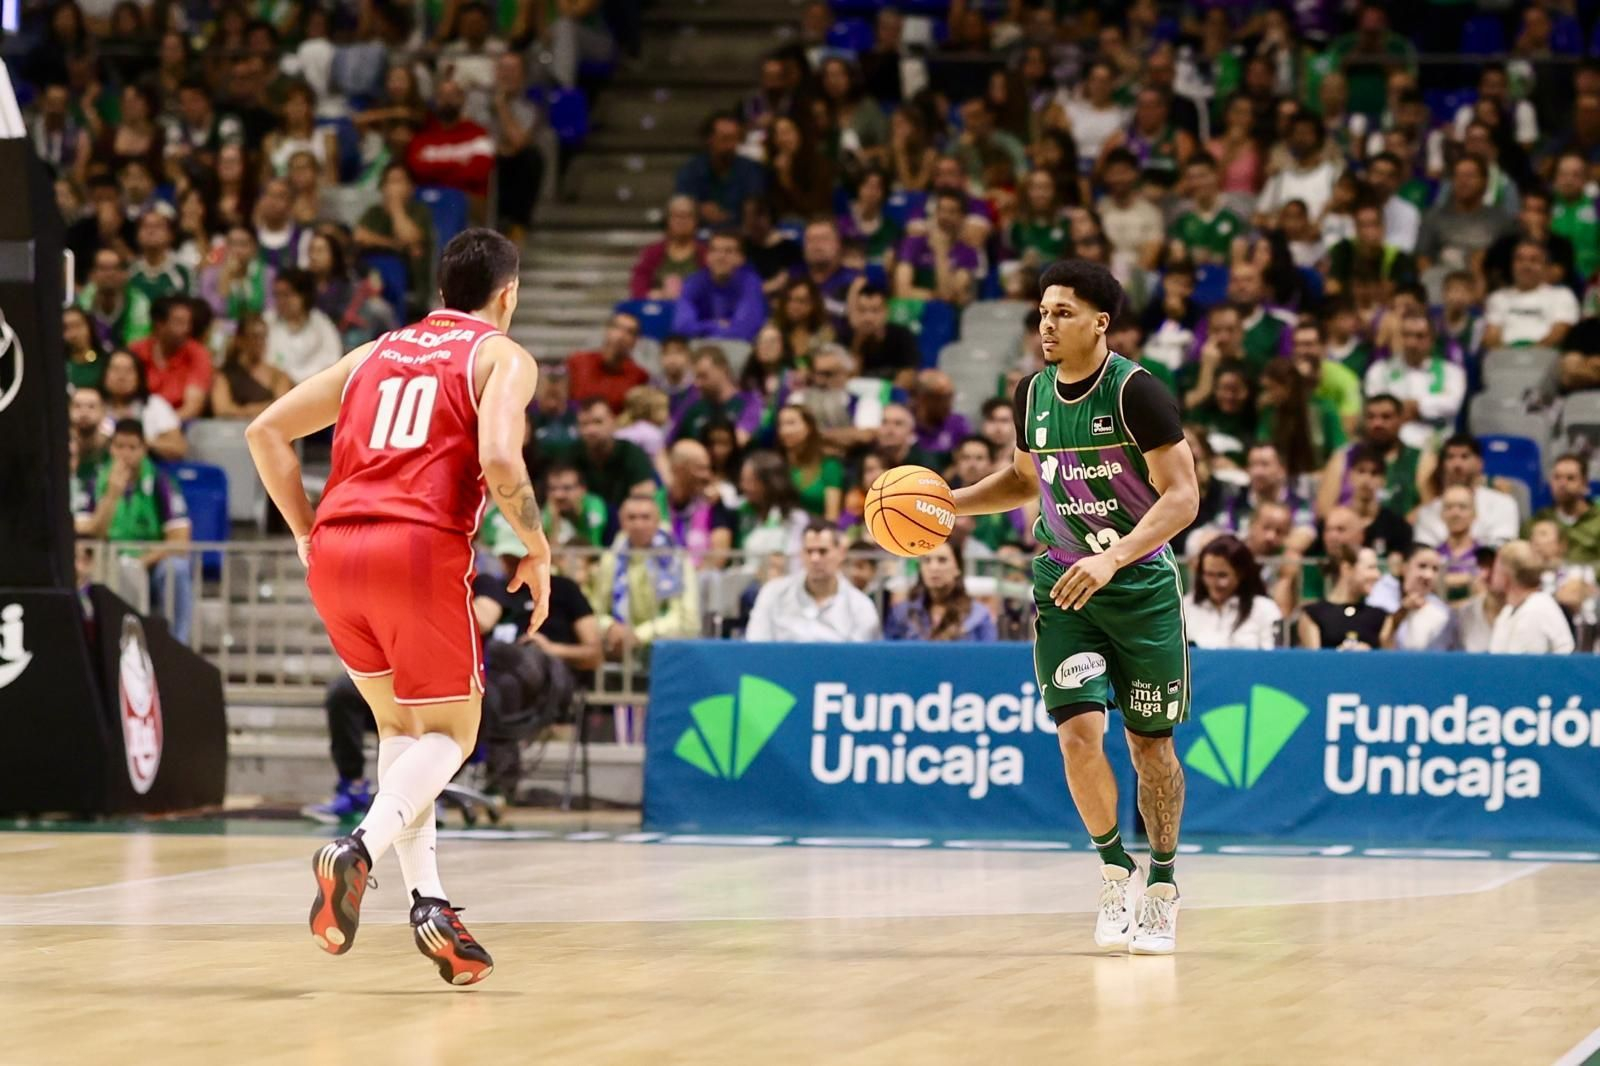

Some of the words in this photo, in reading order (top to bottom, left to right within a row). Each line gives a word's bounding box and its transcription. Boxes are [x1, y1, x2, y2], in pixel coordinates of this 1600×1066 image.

[368, 375, 438, 450] 10
[1061, 460, 1123, 481] Unicaja
[915, 499, 956, 530] Wilson
[812, 682, 1058, 735] Fundaci
[811, 733, 1024, 800] Unicaja
[1323, 744, 1541, 812] Unicaja
